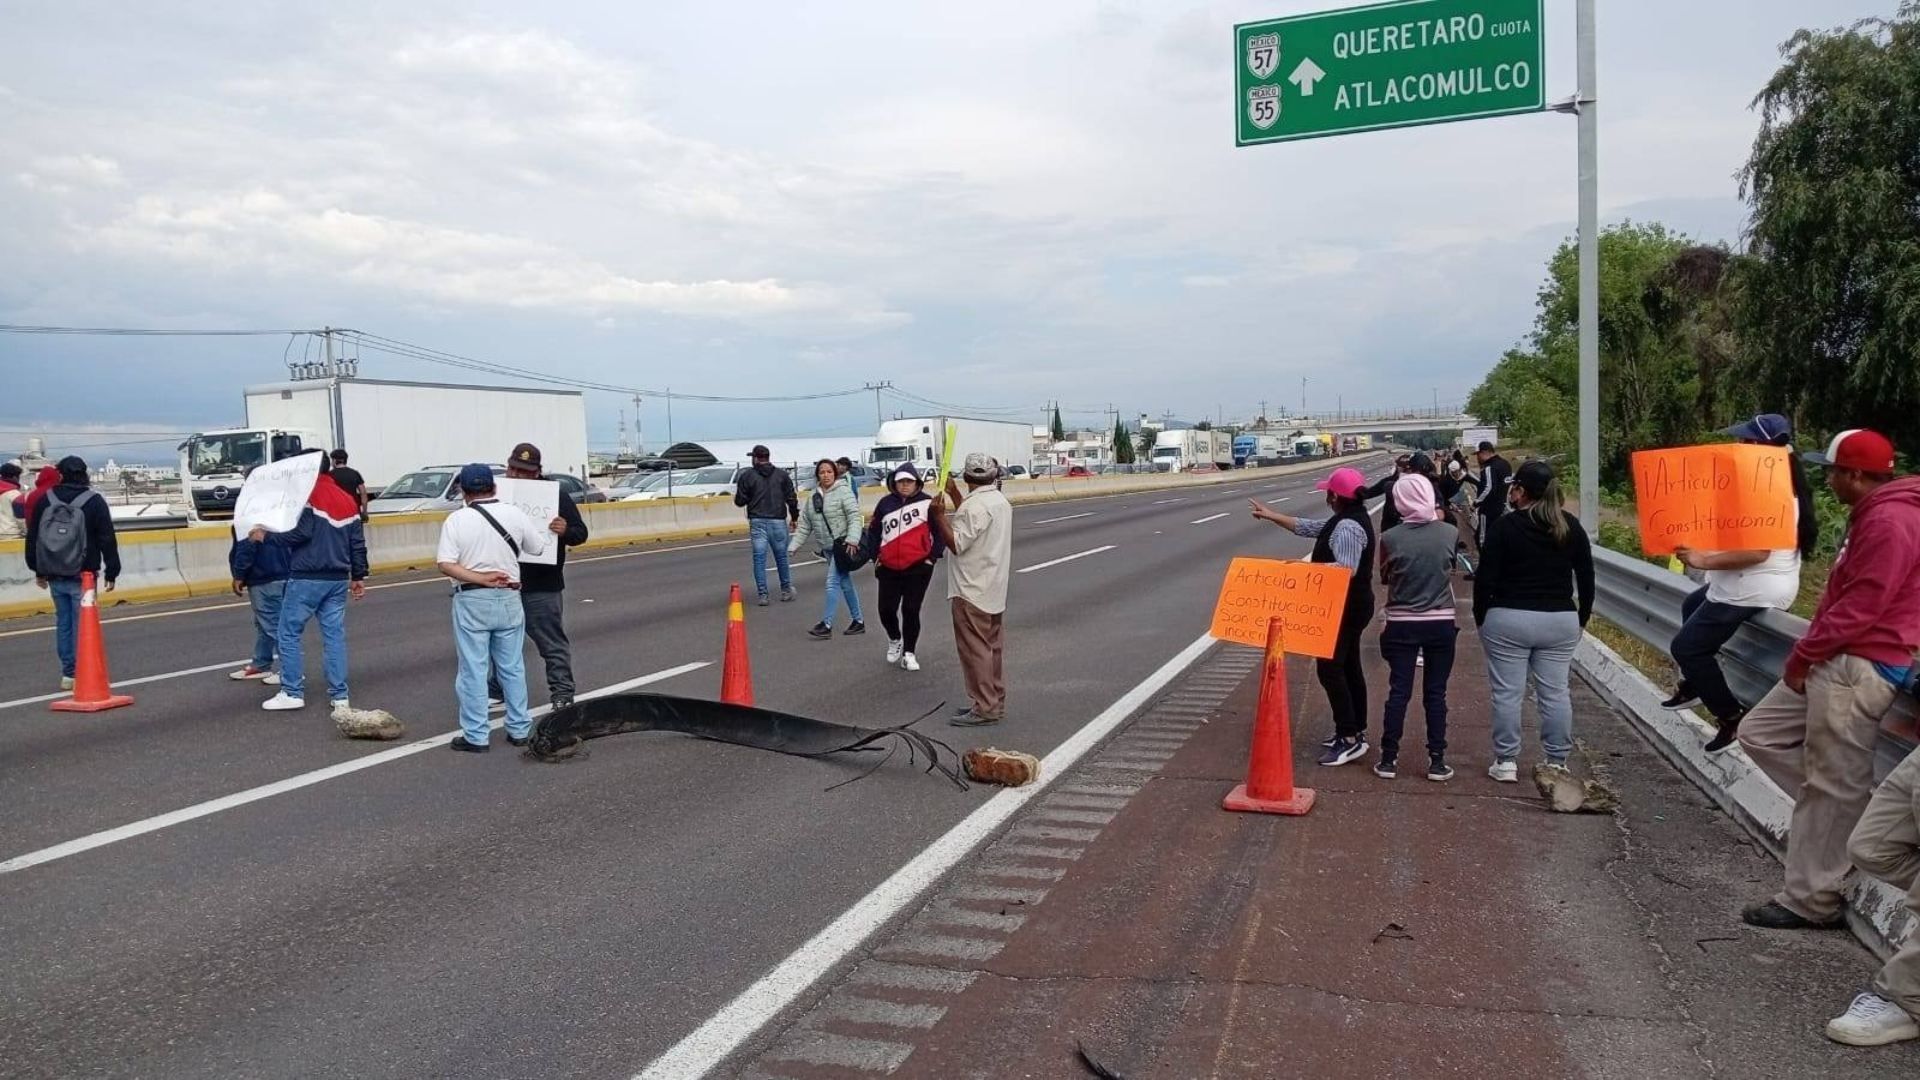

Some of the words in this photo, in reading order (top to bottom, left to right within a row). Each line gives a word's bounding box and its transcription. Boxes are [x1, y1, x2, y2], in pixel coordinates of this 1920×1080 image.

[1251, 36, 1277, 47] MEXICO
[1333, 14, 1484, 58] QUERETARO
[1490, 20, 1531, 38] CUOTA
[1254, 48, 1273, 70] 57
[1251, 87, 1277, 98] MEXICO
[1334, 61, 1530, 111] ATLACOMULCO
[1255, 101, 1274, 121] 55
[1649, 503, 1786, 538] Constitucional
[1305, 572, 1324, 594] 19
[1224, 590, 1333, 620] Constitucional
